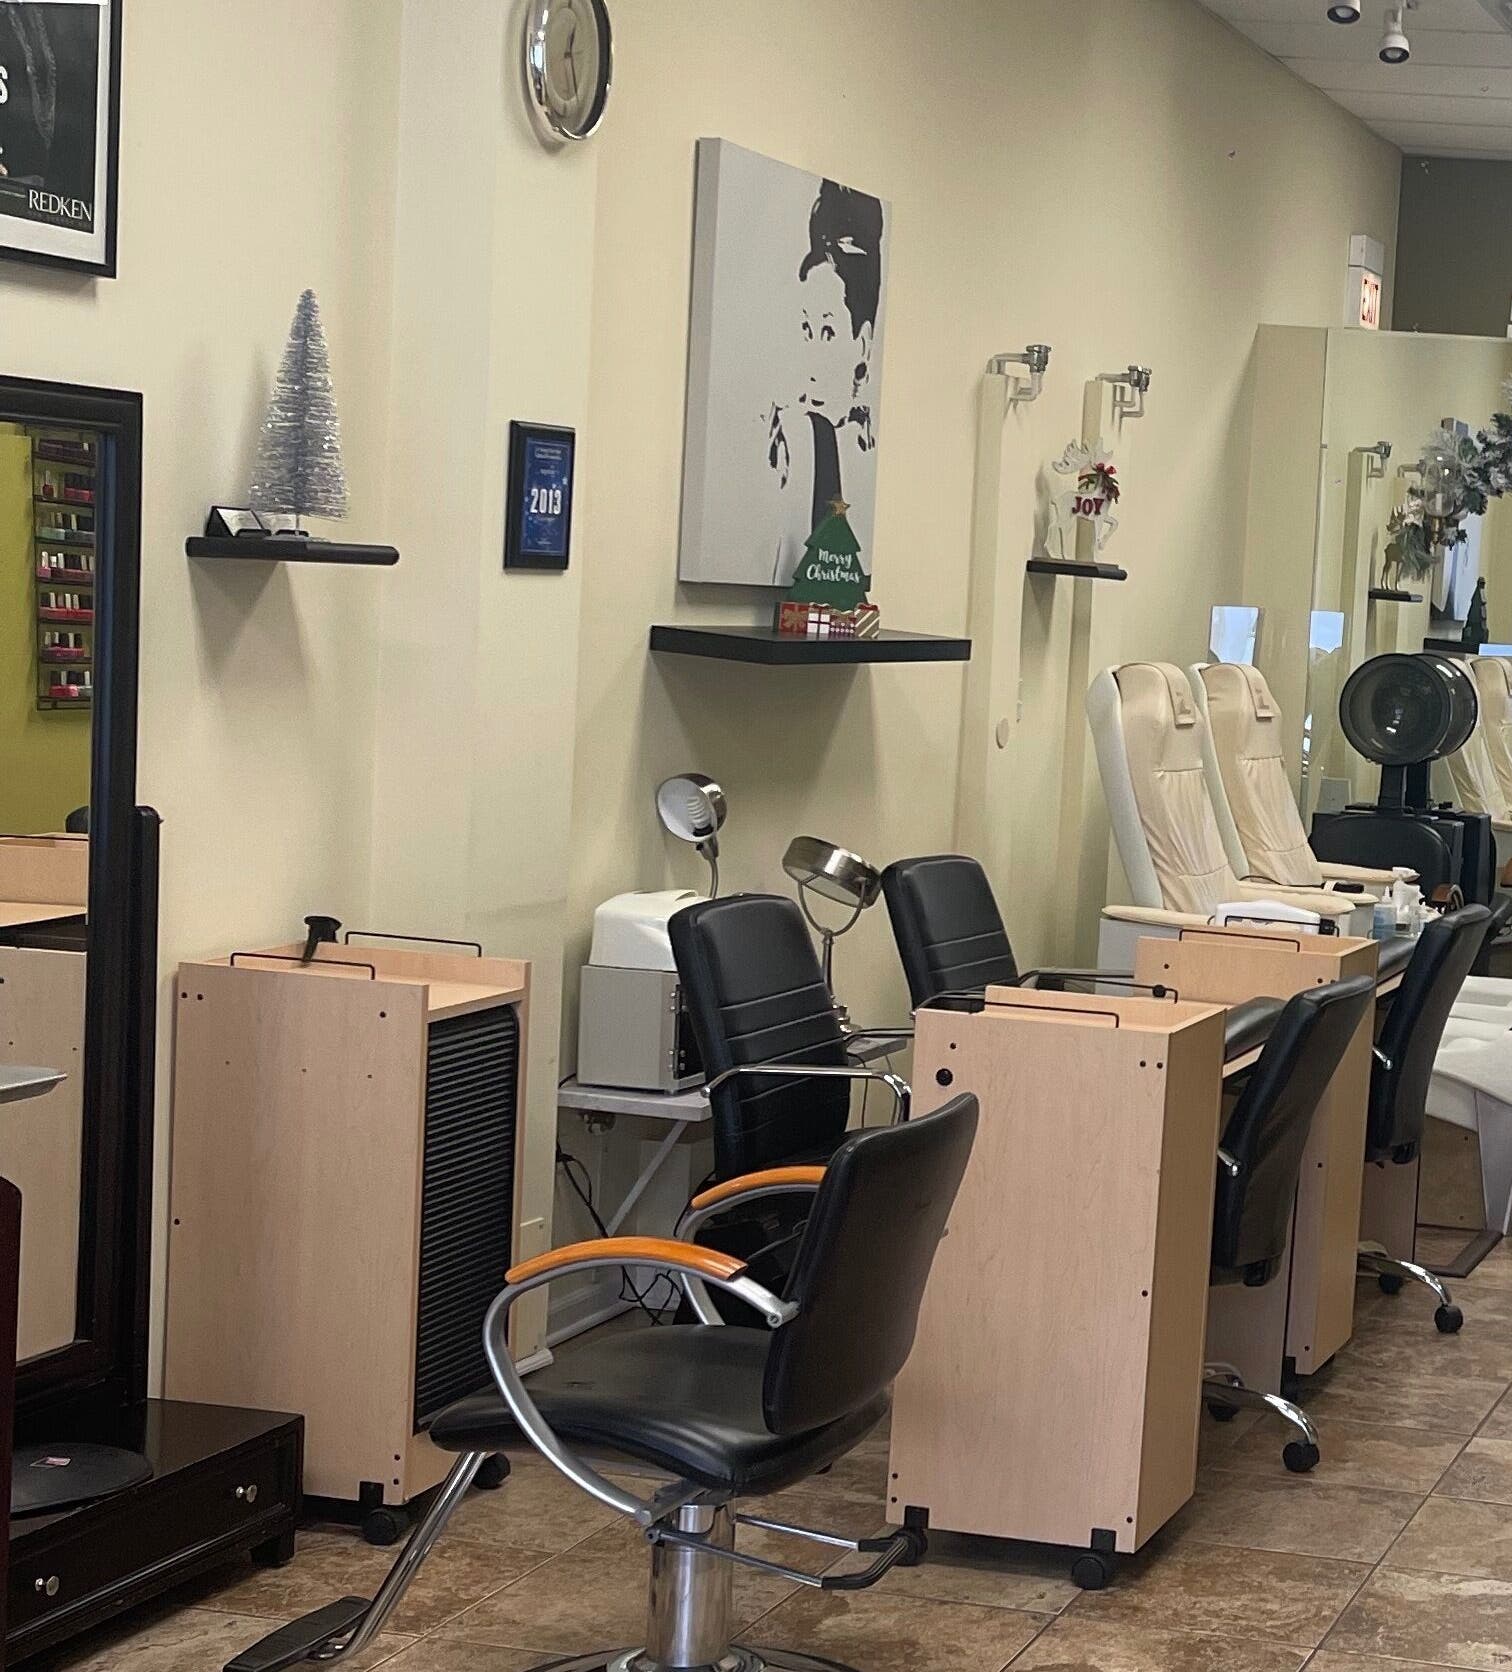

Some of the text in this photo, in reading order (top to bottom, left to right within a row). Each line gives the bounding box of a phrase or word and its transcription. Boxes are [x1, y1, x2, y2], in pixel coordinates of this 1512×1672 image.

[29, 189, 92, 222] REDKEN
[530, 488, 562, 515] 2013
[1072, 496, 1105, 516] JOY
[818, 548, 852, 569] Merry
[806, 563, 860, 583] Christmas
